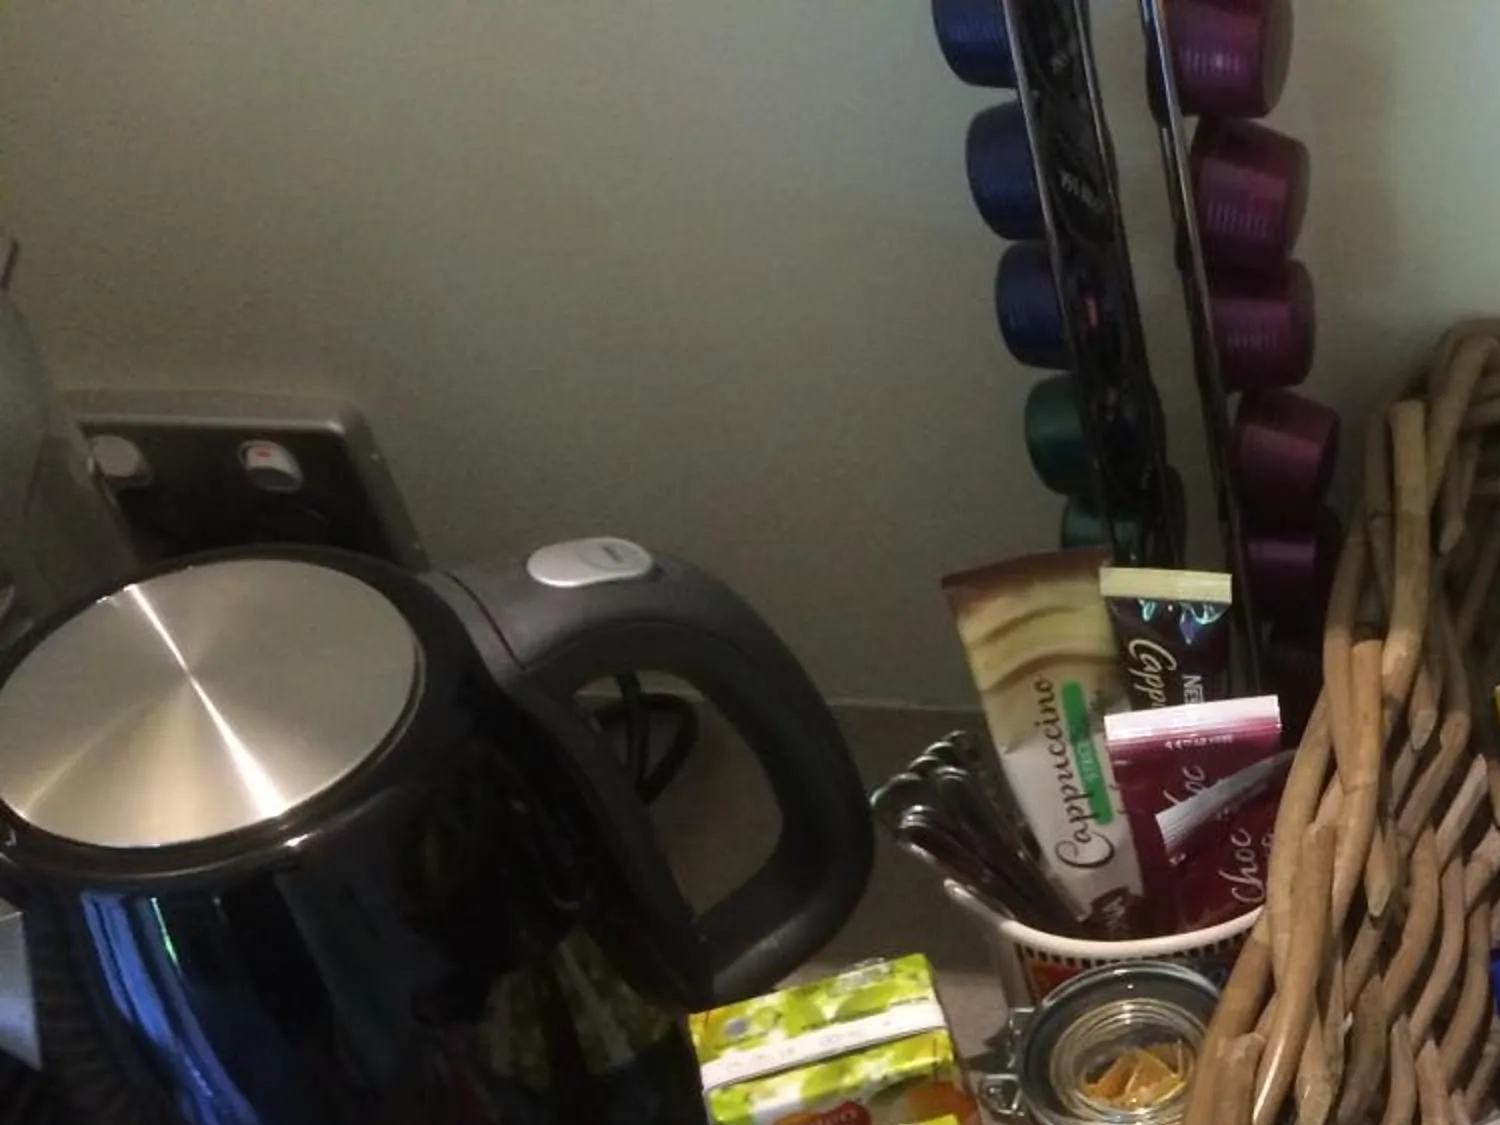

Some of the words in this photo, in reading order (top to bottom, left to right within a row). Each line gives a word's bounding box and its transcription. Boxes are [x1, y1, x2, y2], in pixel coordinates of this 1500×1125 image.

[1129, 639, 1177, 709] Capp
[1033, 675, 1115, 870] Cappuccino
[1218, 827, 1267, 904] Choc
